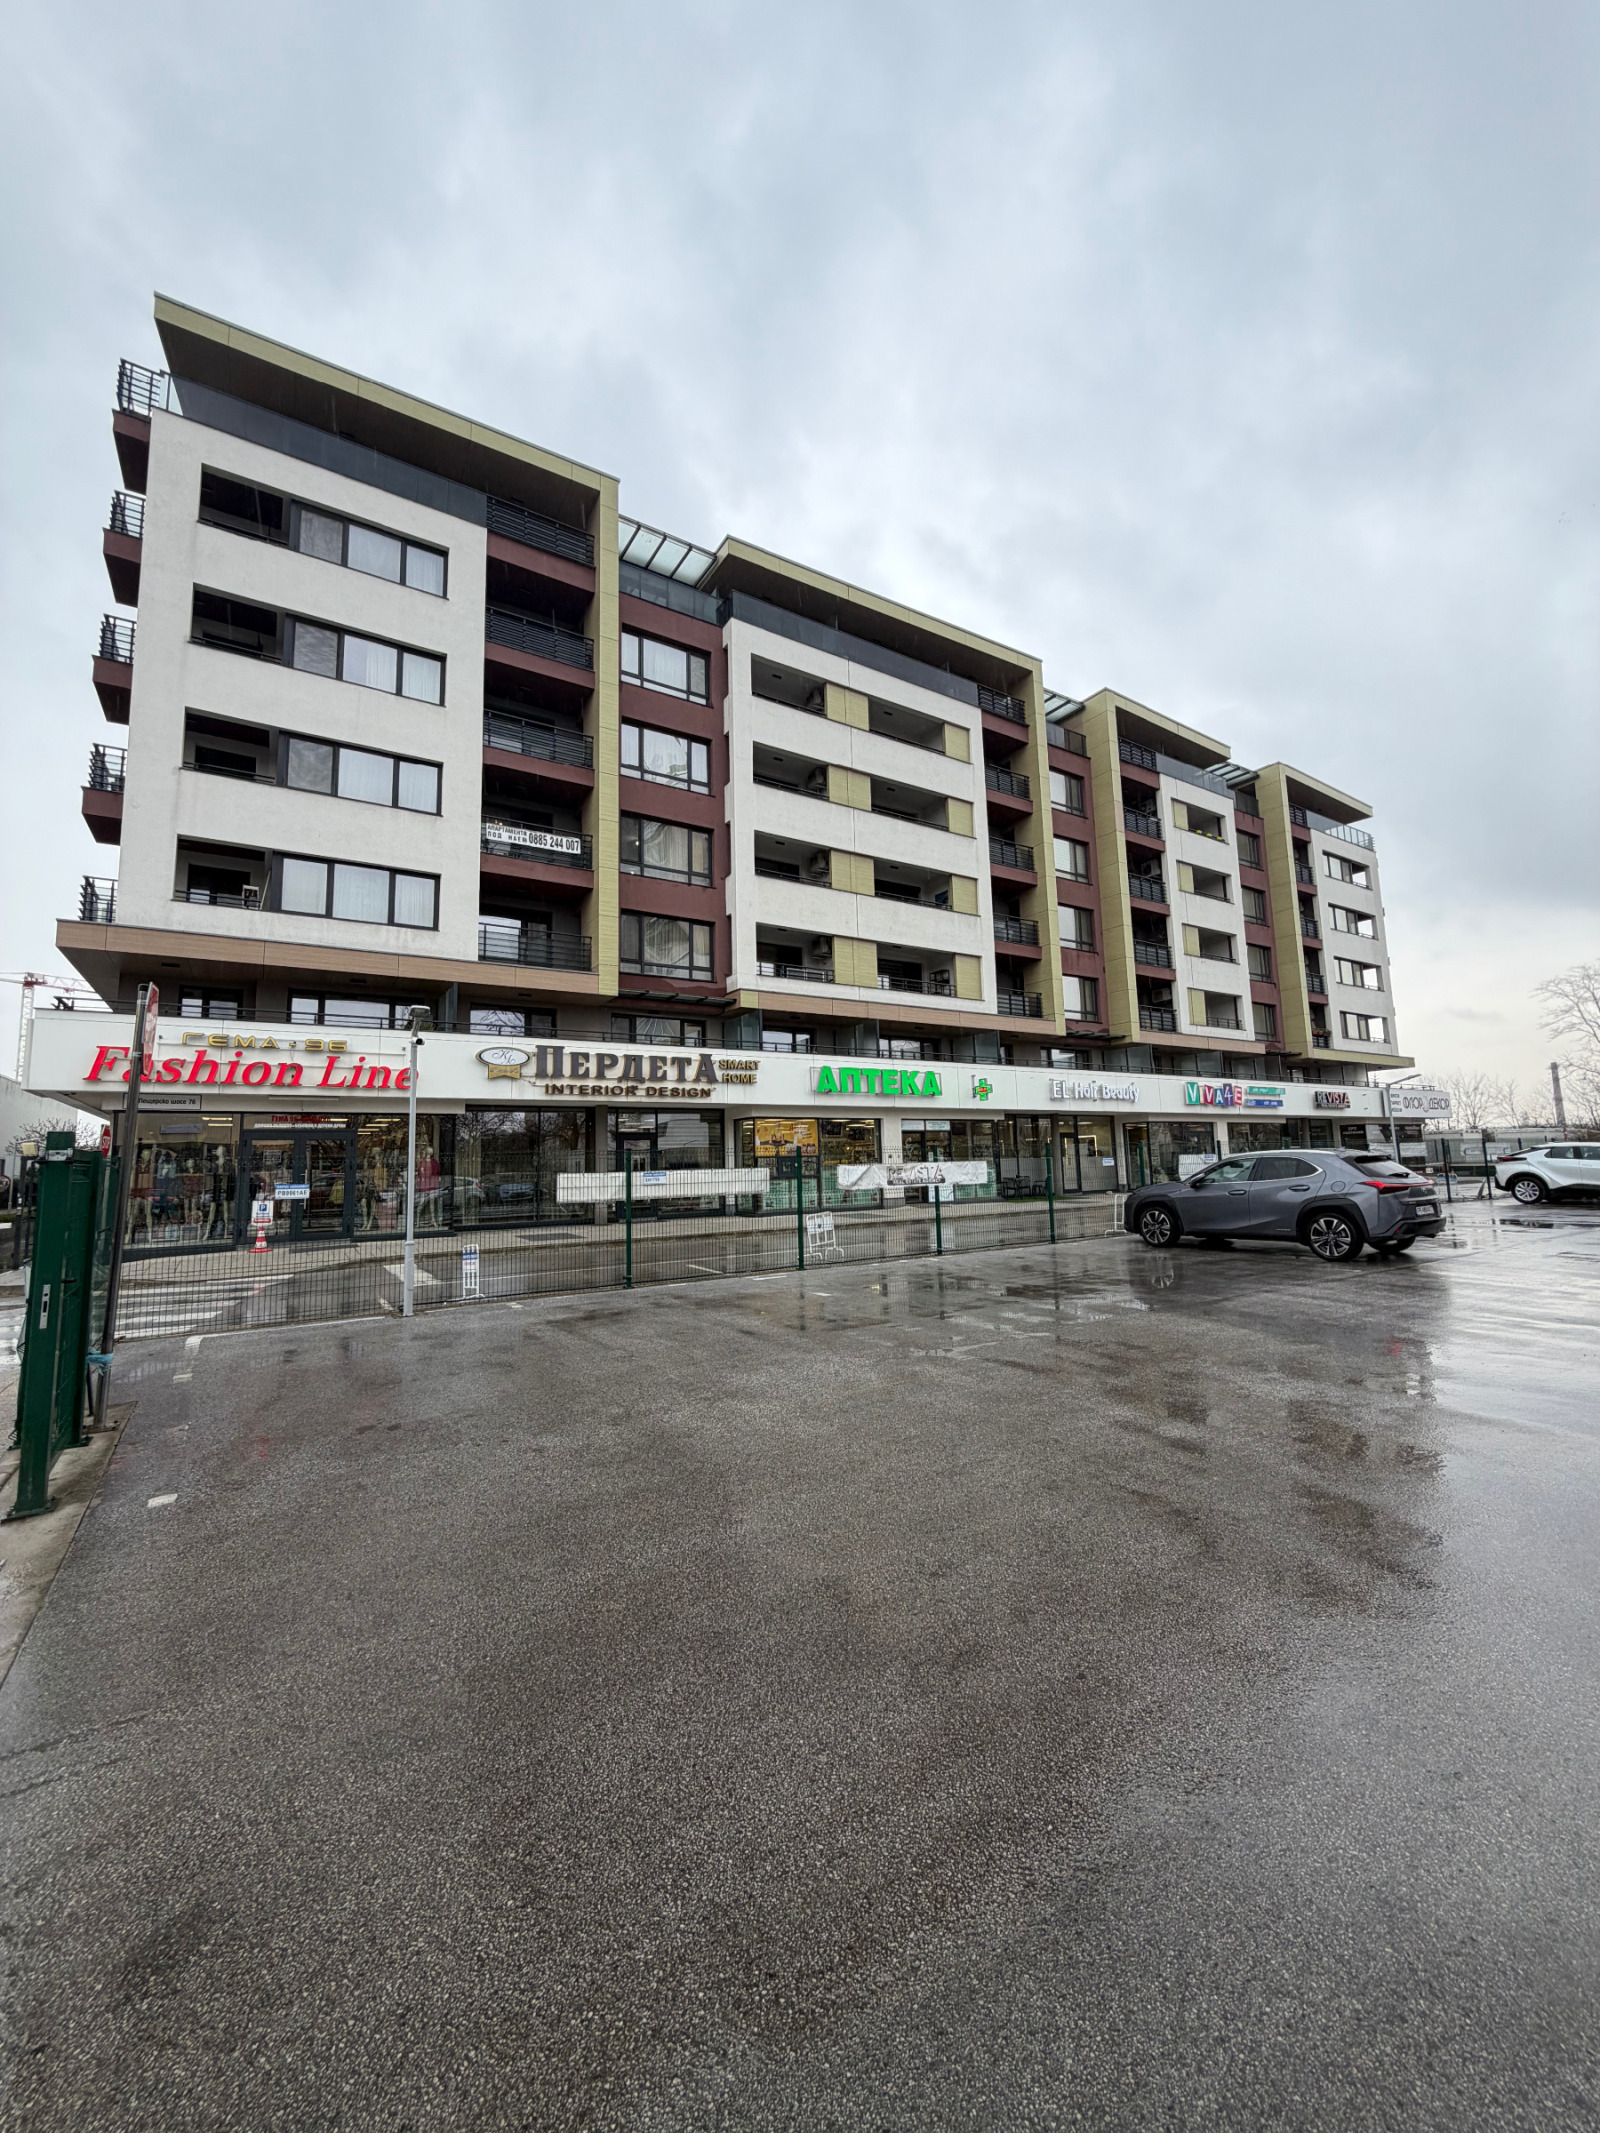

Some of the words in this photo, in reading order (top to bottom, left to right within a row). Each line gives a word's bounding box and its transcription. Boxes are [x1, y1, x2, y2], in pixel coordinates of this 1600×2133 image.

[487, 831, 503, 839] ПОД
[528, 832, 548, 846] 0885
[549, 836, 564, 850] 244
[565, 839, 580, 852] 007
[182, 1032, 280, 1050] ГЕМА
[304, 1038, 348, 1052] 96
[316, 1056, 419, 1090] Line
[535, 1045, 718, 1084] ПЕРДЕТА
[718, 1059, 761, 1071] SMART
[722, 1073, 758, 1084] HOME
[817, 1066, 942, 1096] АПТЕКА
[545, 1083, 640, 1096] INTERIOR
[645, 1086, 712, 1098] DESIGN
[1053, 1081, 1070, 1098] EL
[1074, 1083, 1098, 1099] Hair
[1102, 1084, 1140, 1102] Beauty
[1317, 1091, 1350, 1104] REVISTA
